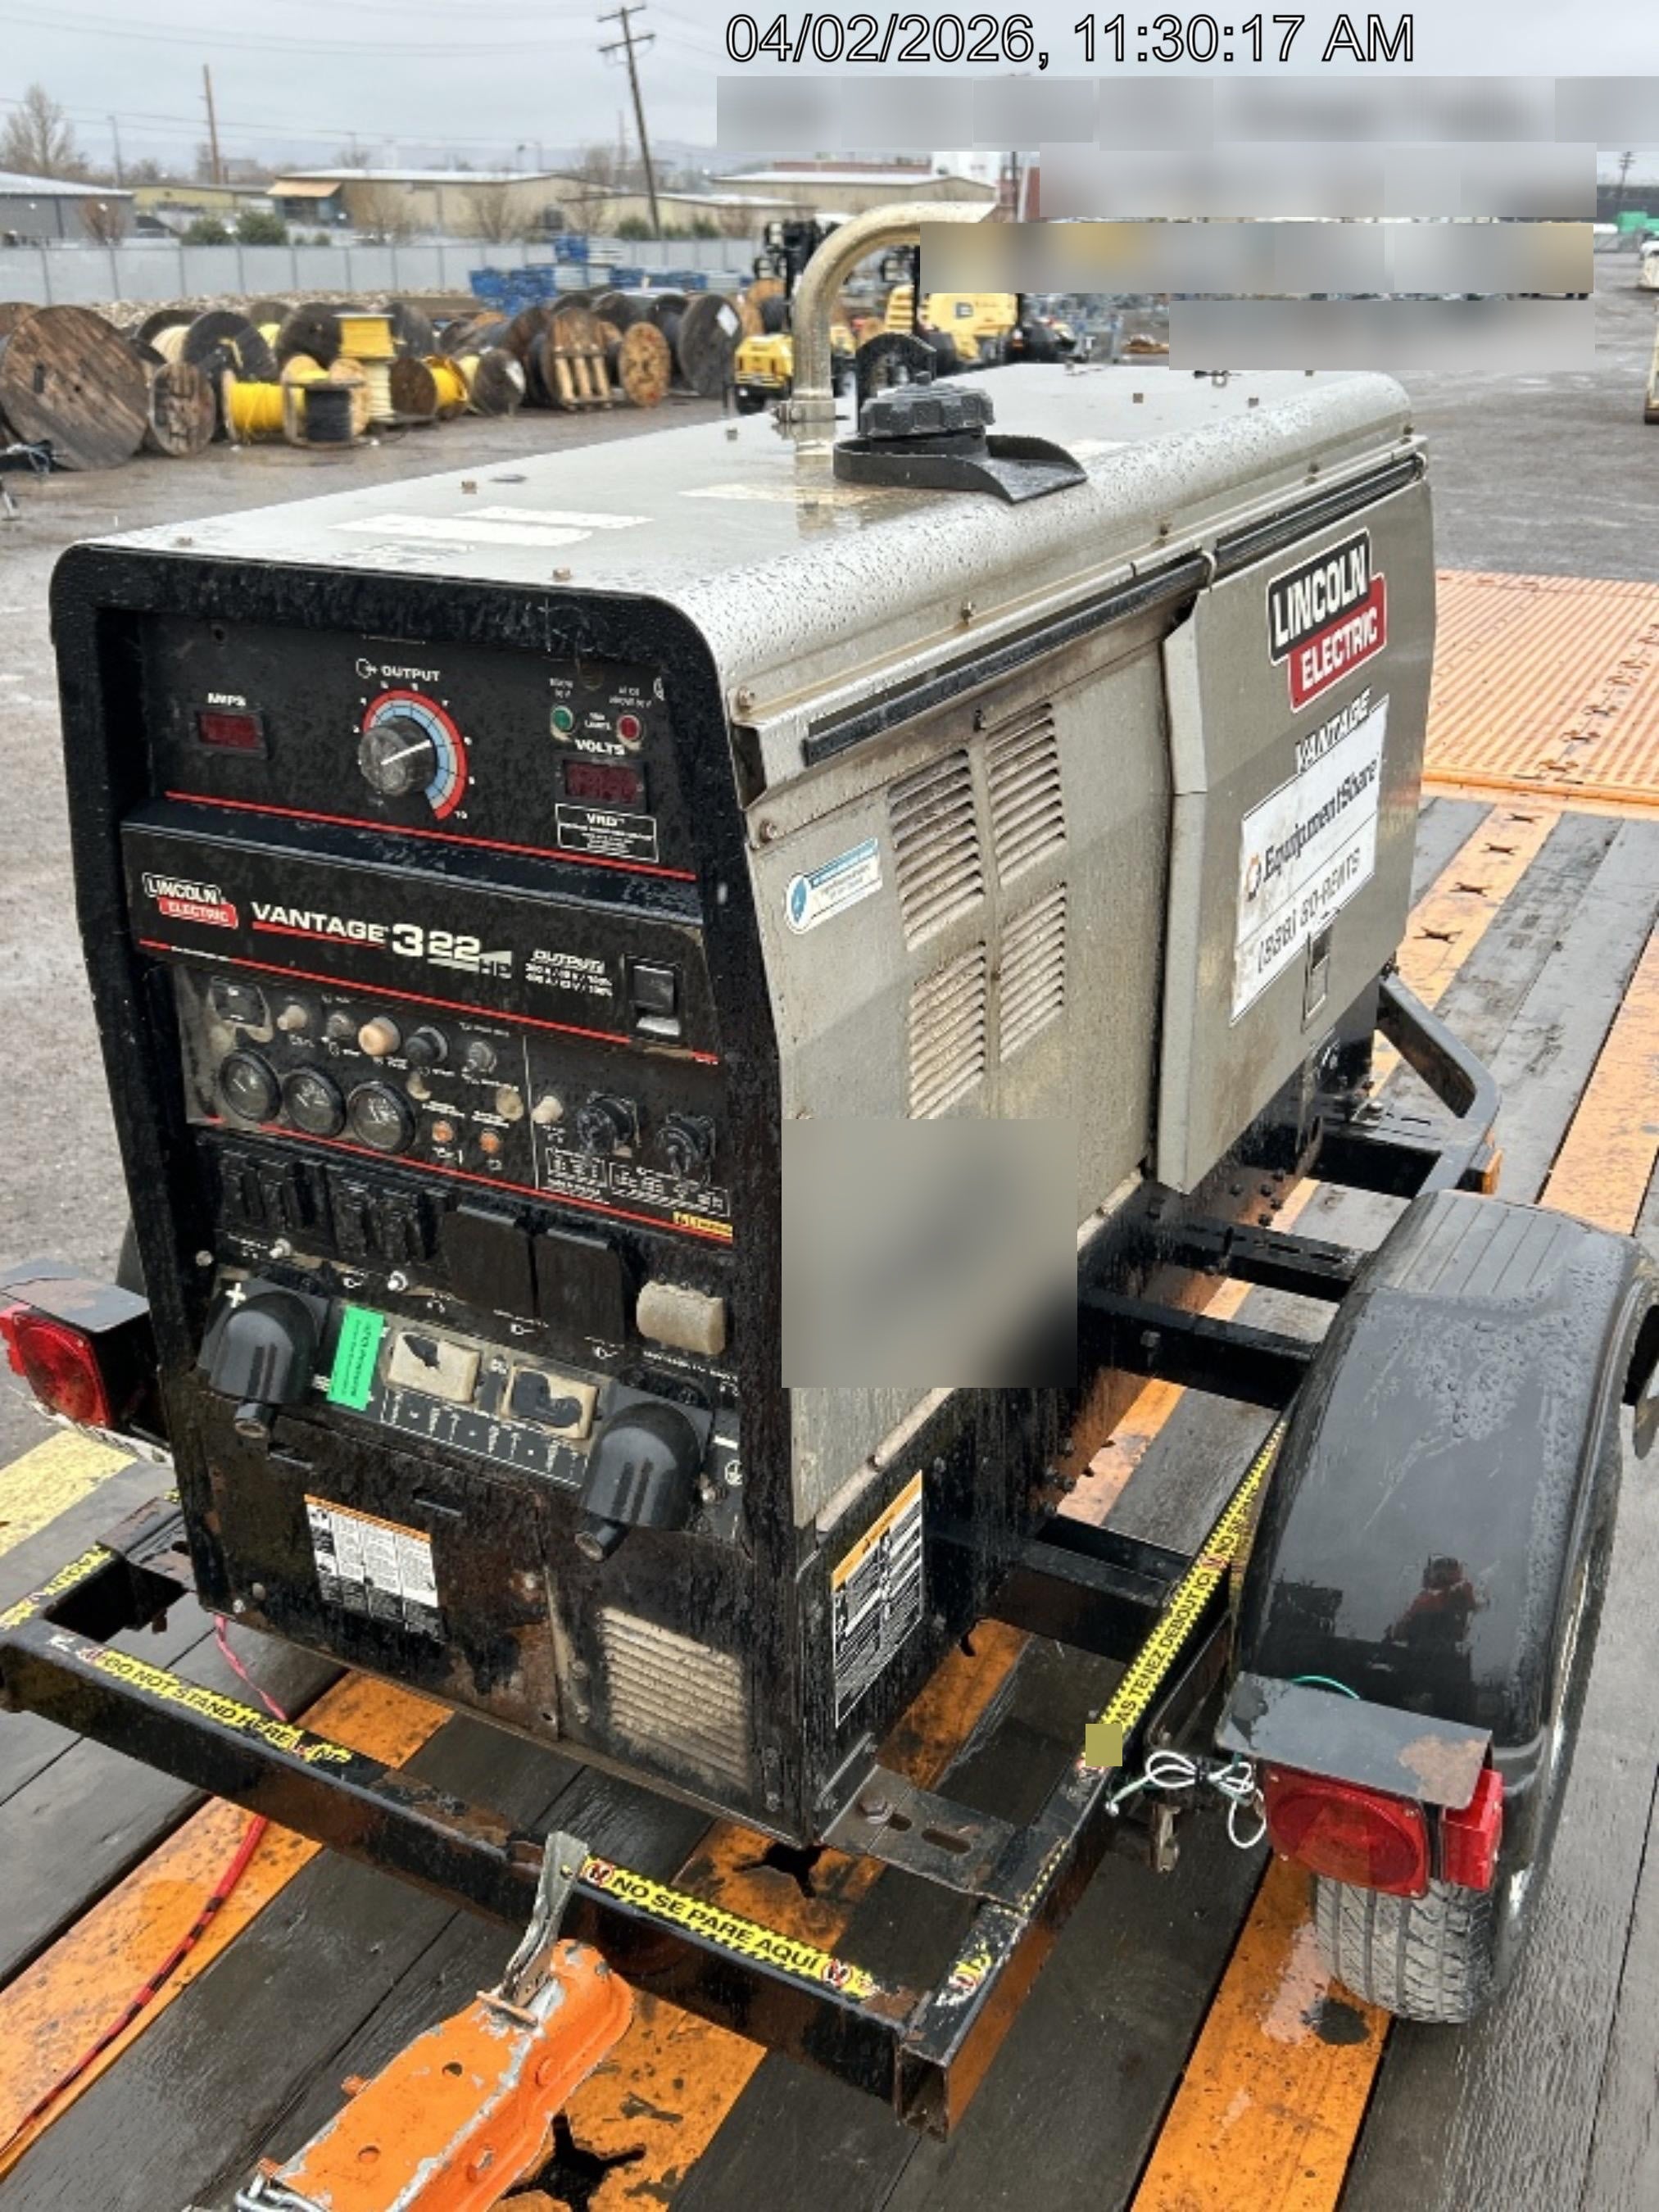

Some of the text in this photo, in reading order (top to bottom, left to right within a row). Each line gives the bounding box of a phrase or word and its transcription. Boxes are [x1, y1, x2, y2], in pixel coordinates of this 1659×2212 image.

[1273, 543, 1367, 647] LINCOLN
[381, 666, 441, 682] OUTPUT
[1302, 607, 1378, 691] ELECTRIC
[575, 739, 625, 755] VOLTS
[1264, 759, 1376, 882] EquipmentShare
[148, 878, 216, 904] LINCOLN
[168, 900, 229, 922] ELECTRIC
[251, 902, 480, 963] VANTAGE 322
[1129, 1649, 1167, 1696] TENEZ
[1160, 1593, 1198, 1648] DEBOUT
[104, 1655, 294, 1744] DO NOT STAND HERE
[613, 1878, 650, 1898] NO
[652, 1892, 685, 1913] SE
[687, 1908, 755, 1943] PARE
